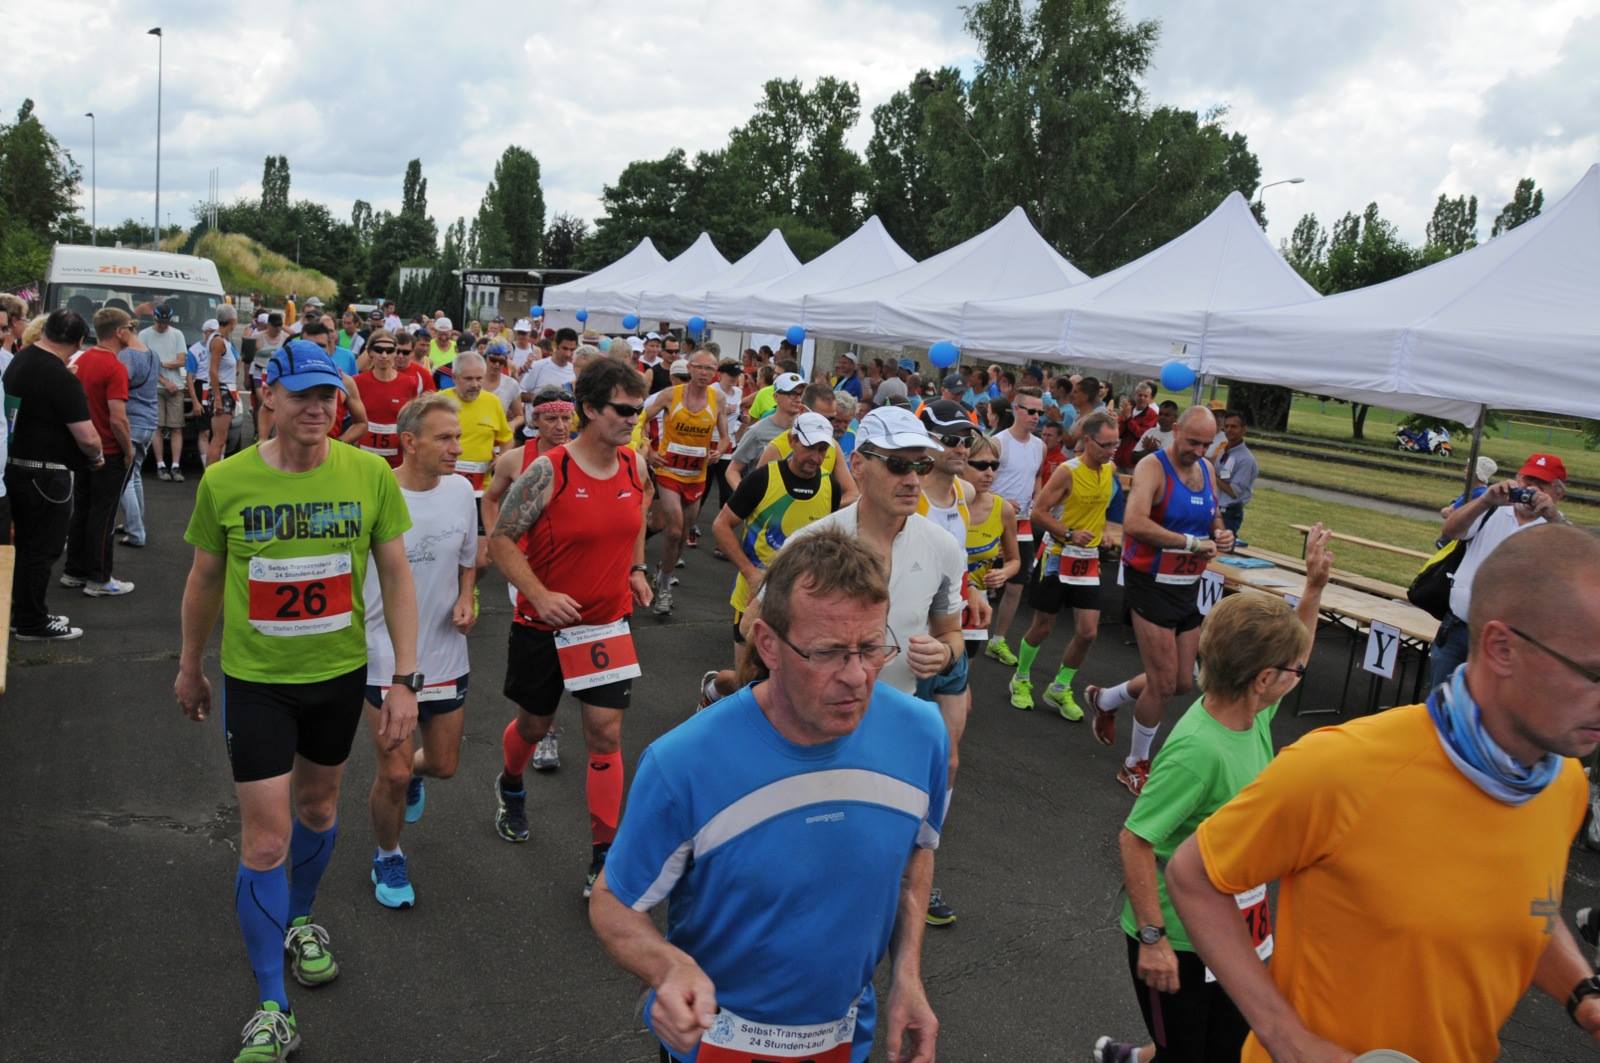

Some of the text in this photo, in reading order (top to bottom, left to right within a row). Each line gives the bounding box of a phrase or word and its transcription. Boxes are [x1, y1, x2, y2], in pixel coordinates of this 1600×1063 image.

[295, 502, 361, 521] MEILEN
[239, 503, 295, 543] 100
[296, 520, 360, 539] BERLIN
[1071, 559, 1089, 577] 69
[1174, 554, 1198, 574] 25
[275, 582, 327, 618] 26
[1200, 577, 1224, 606] W
[591, 642, 609, 670] 6
[1373, 629, 1396, 670] Y
[740, 1023, 834, 1039] Selbst-Transzendenz
[749, 1037, 825, 1051] 24 Stunden-Lauf
